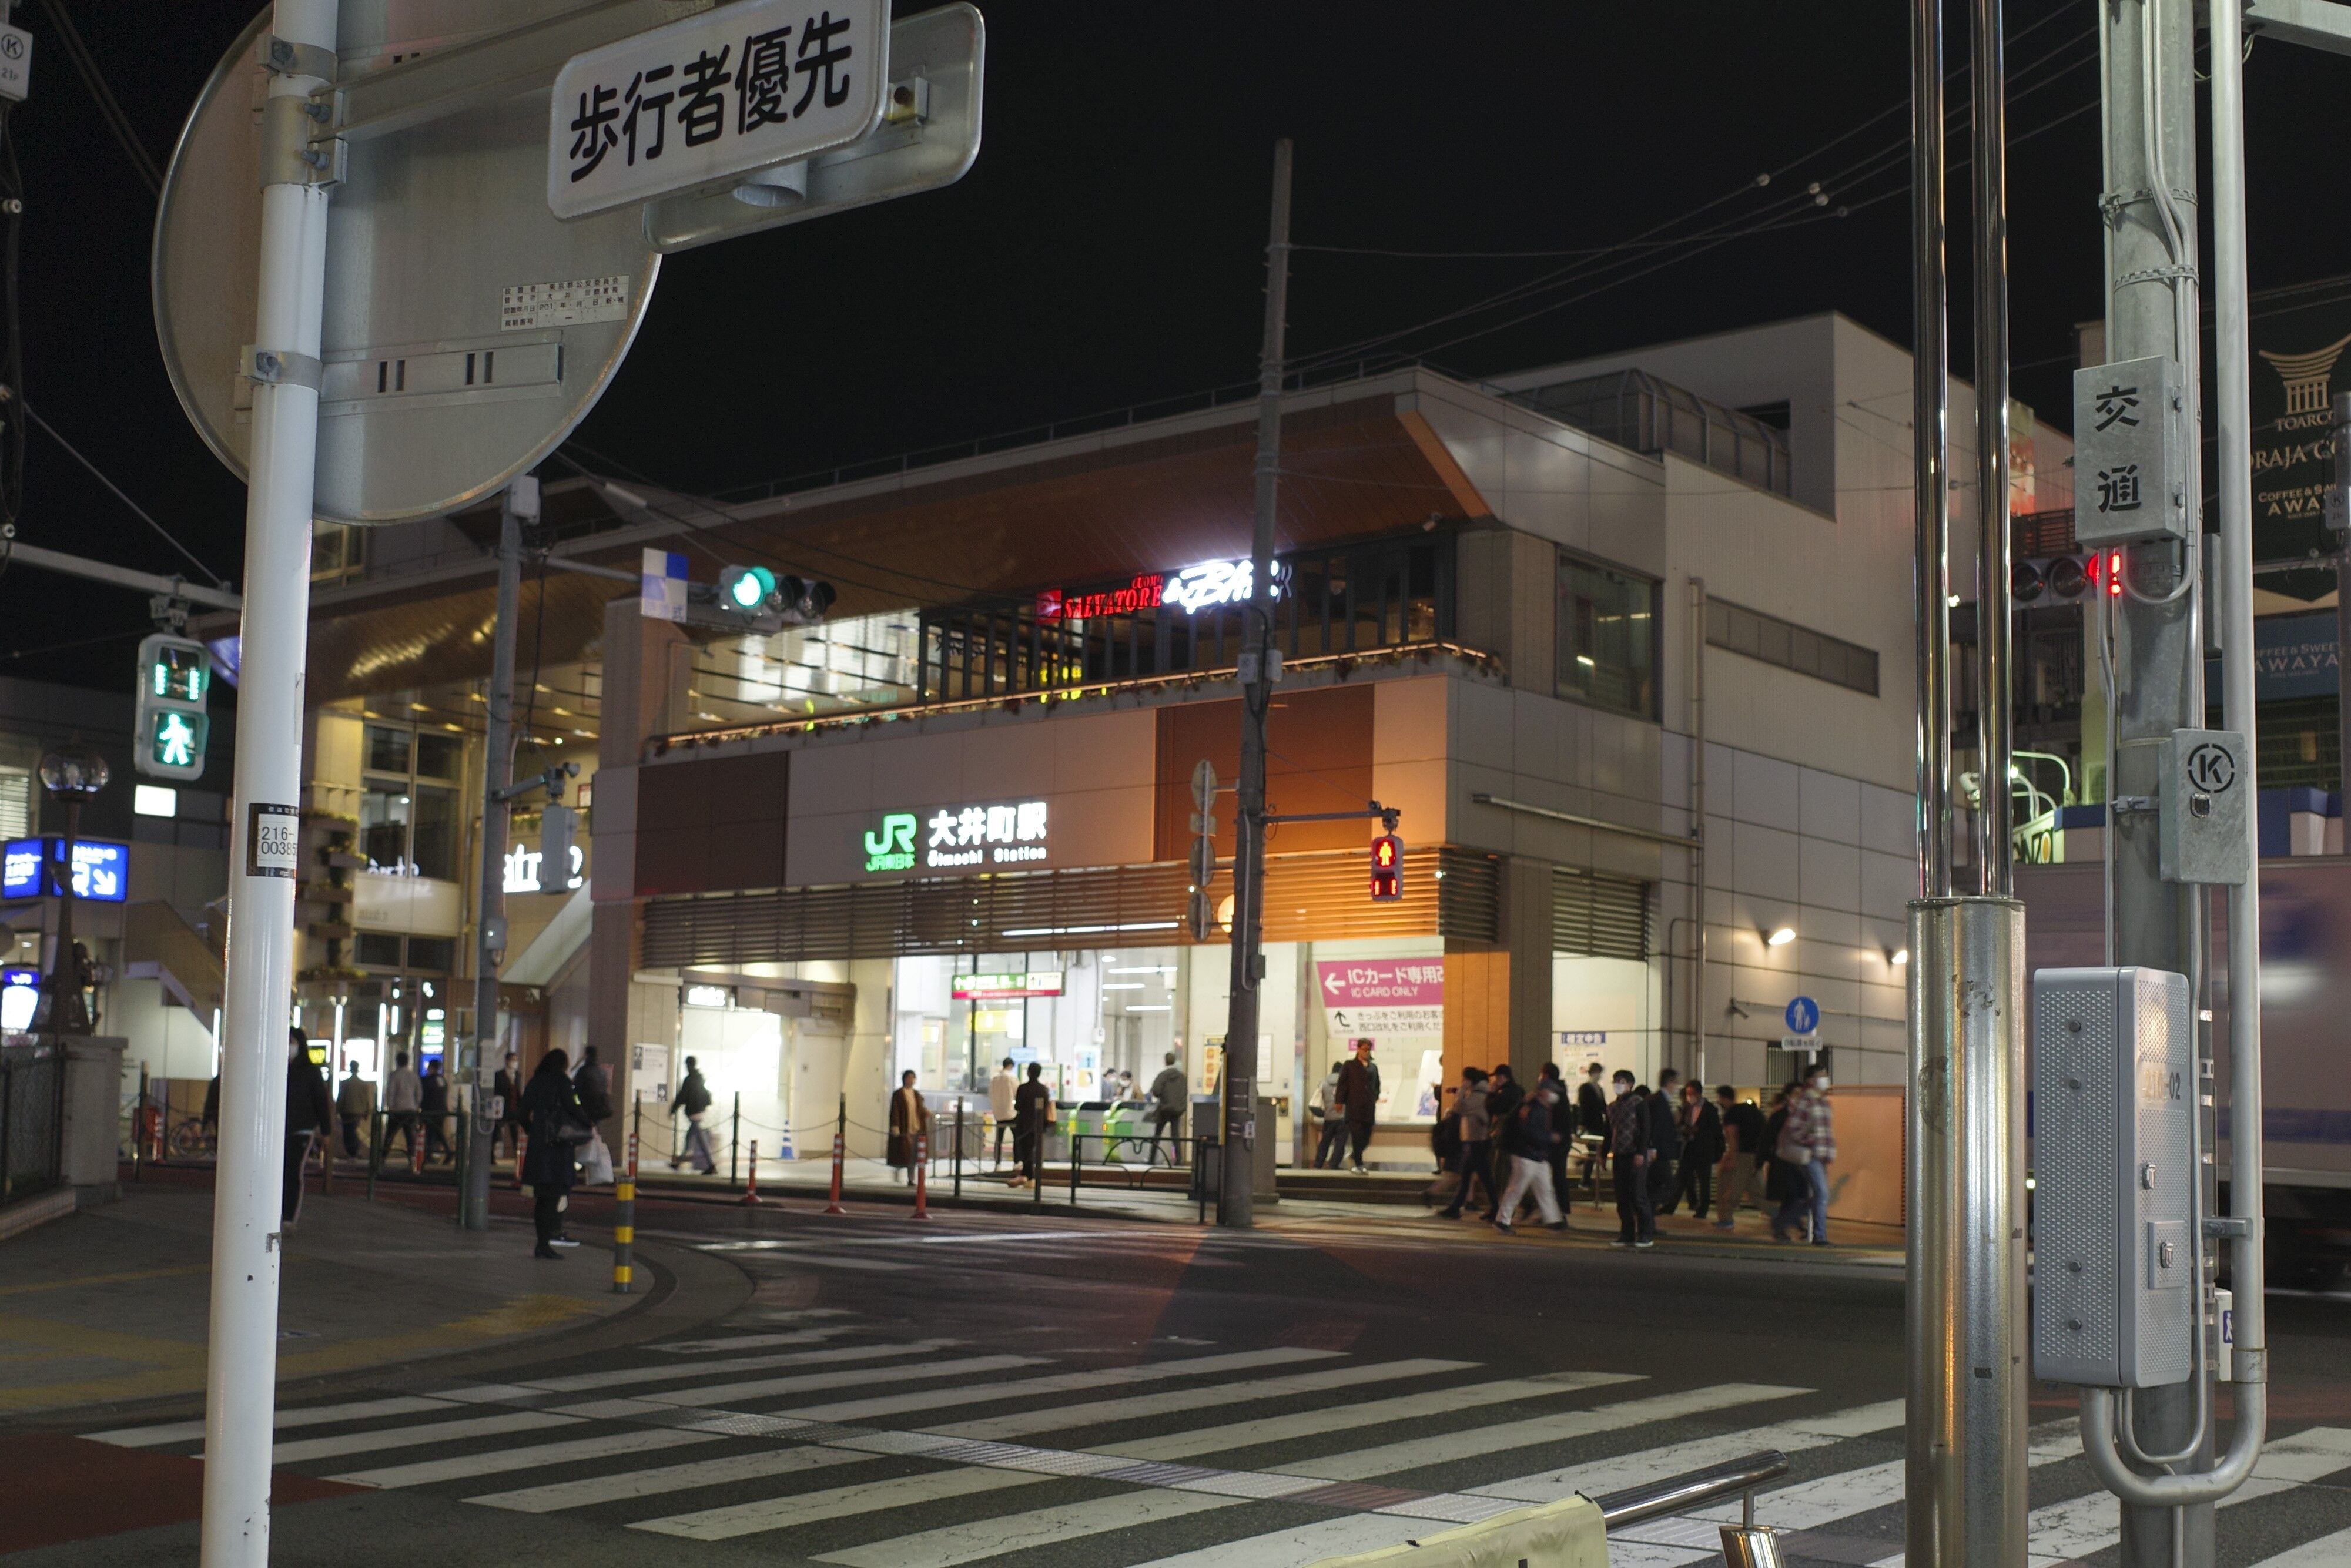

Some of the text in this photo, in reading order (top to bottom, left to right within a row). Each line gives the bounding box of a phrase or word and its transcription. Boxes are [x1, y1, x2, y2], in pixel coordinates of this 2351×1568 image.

[570, 11, 852, 183] 歩行者優先
[2095, 386, 2142, 514] 交通
[2251, 444, 2308, 470] RAJA
[2258, 487, 2303, 502] COFFEE
[2268, 496, 2326, 516] AWA
[1064, 584, 1163, 618] SALVATORE
[865, 802, 1047, 855] JR 大井町駅
[865, 854, 915, 872] JR東日本
[994, 846, 1046, 863] Station
[1351, 986, 1418, 998] IC CARD ONLY
[1357, 1011, 1444, 1021] きっぷをご利用のお客
